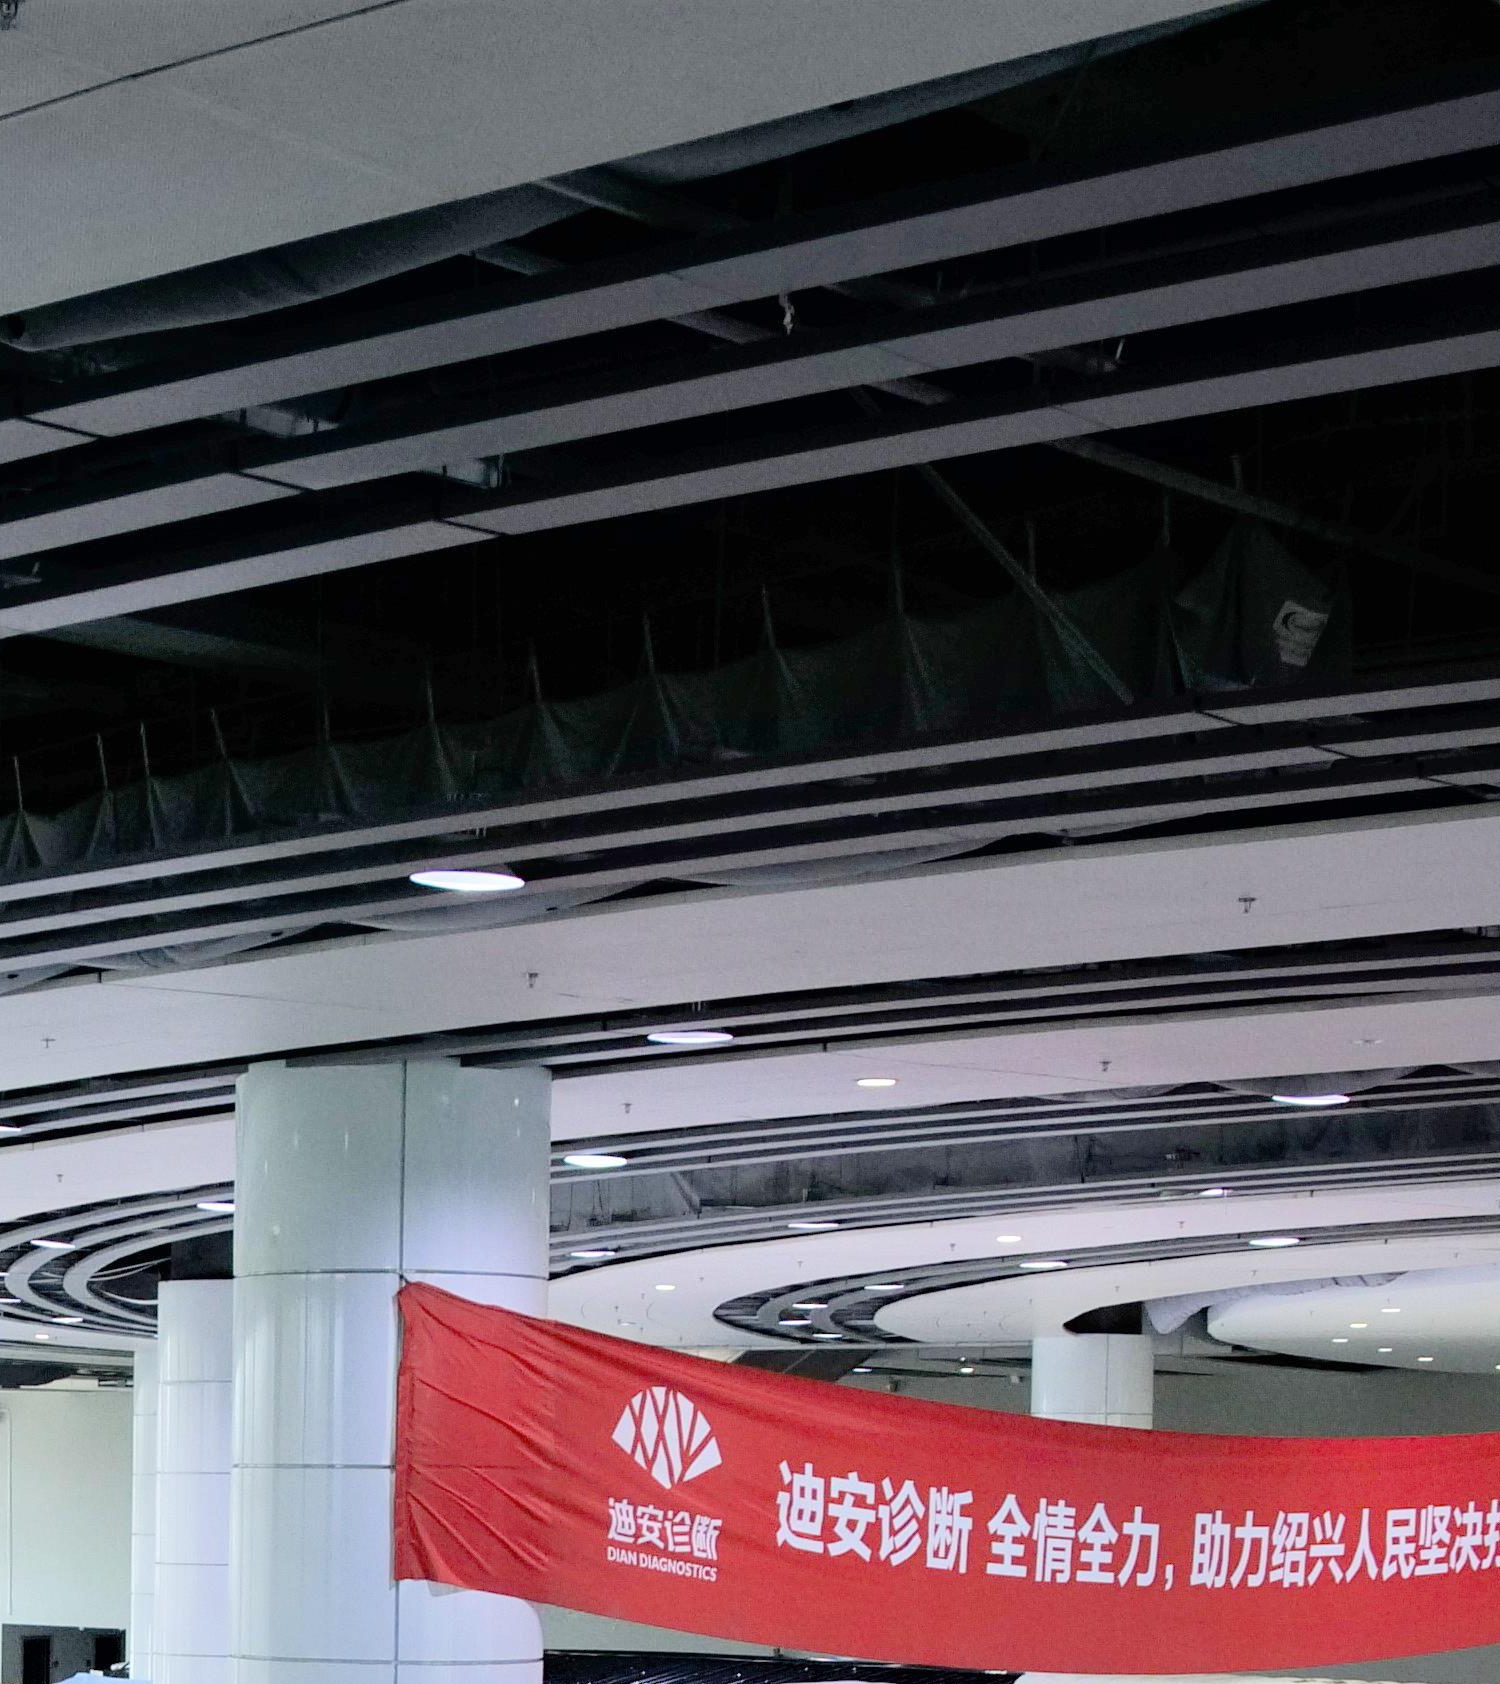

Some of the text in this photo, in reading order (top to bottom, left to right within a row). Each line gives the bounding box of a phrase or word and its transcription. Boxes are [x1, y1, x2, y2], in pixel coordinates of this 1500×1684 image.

[607, 1497, 722, 1560] 迪安诊断
[776, 1460, 973, 1574] 迪安诊断
[607, 1546, 717, 1581] DIAN DIAGNOSTICS
